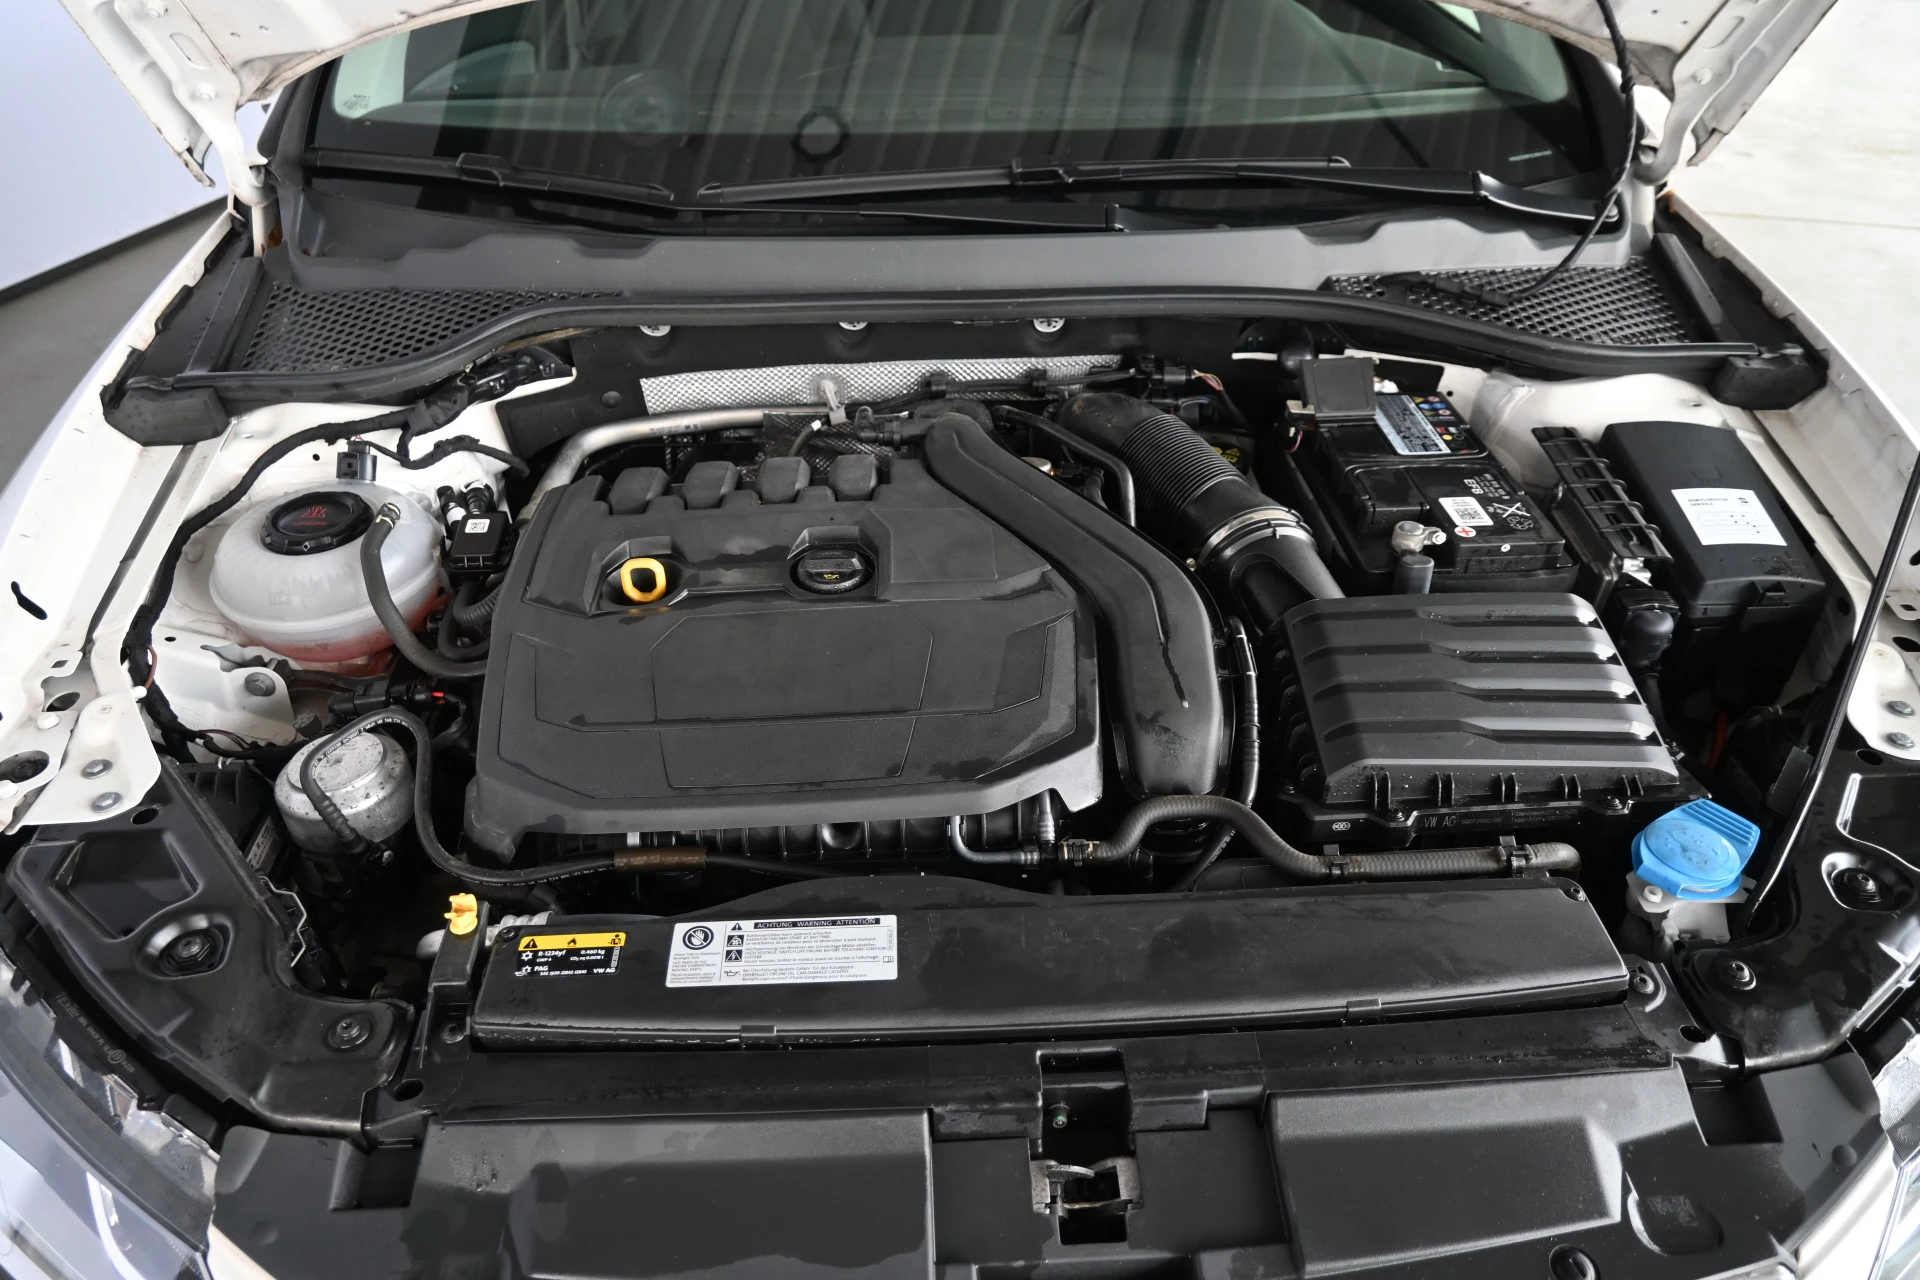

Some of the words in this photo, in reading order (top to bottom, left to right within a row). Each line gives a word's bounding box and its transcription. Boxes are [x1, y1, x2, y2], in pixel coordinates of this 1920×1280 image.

[1464, 479, 1483, 494] EFB
[1424, 816, 1438, 828] VW
[1442, 816, 1457, 826] AG
